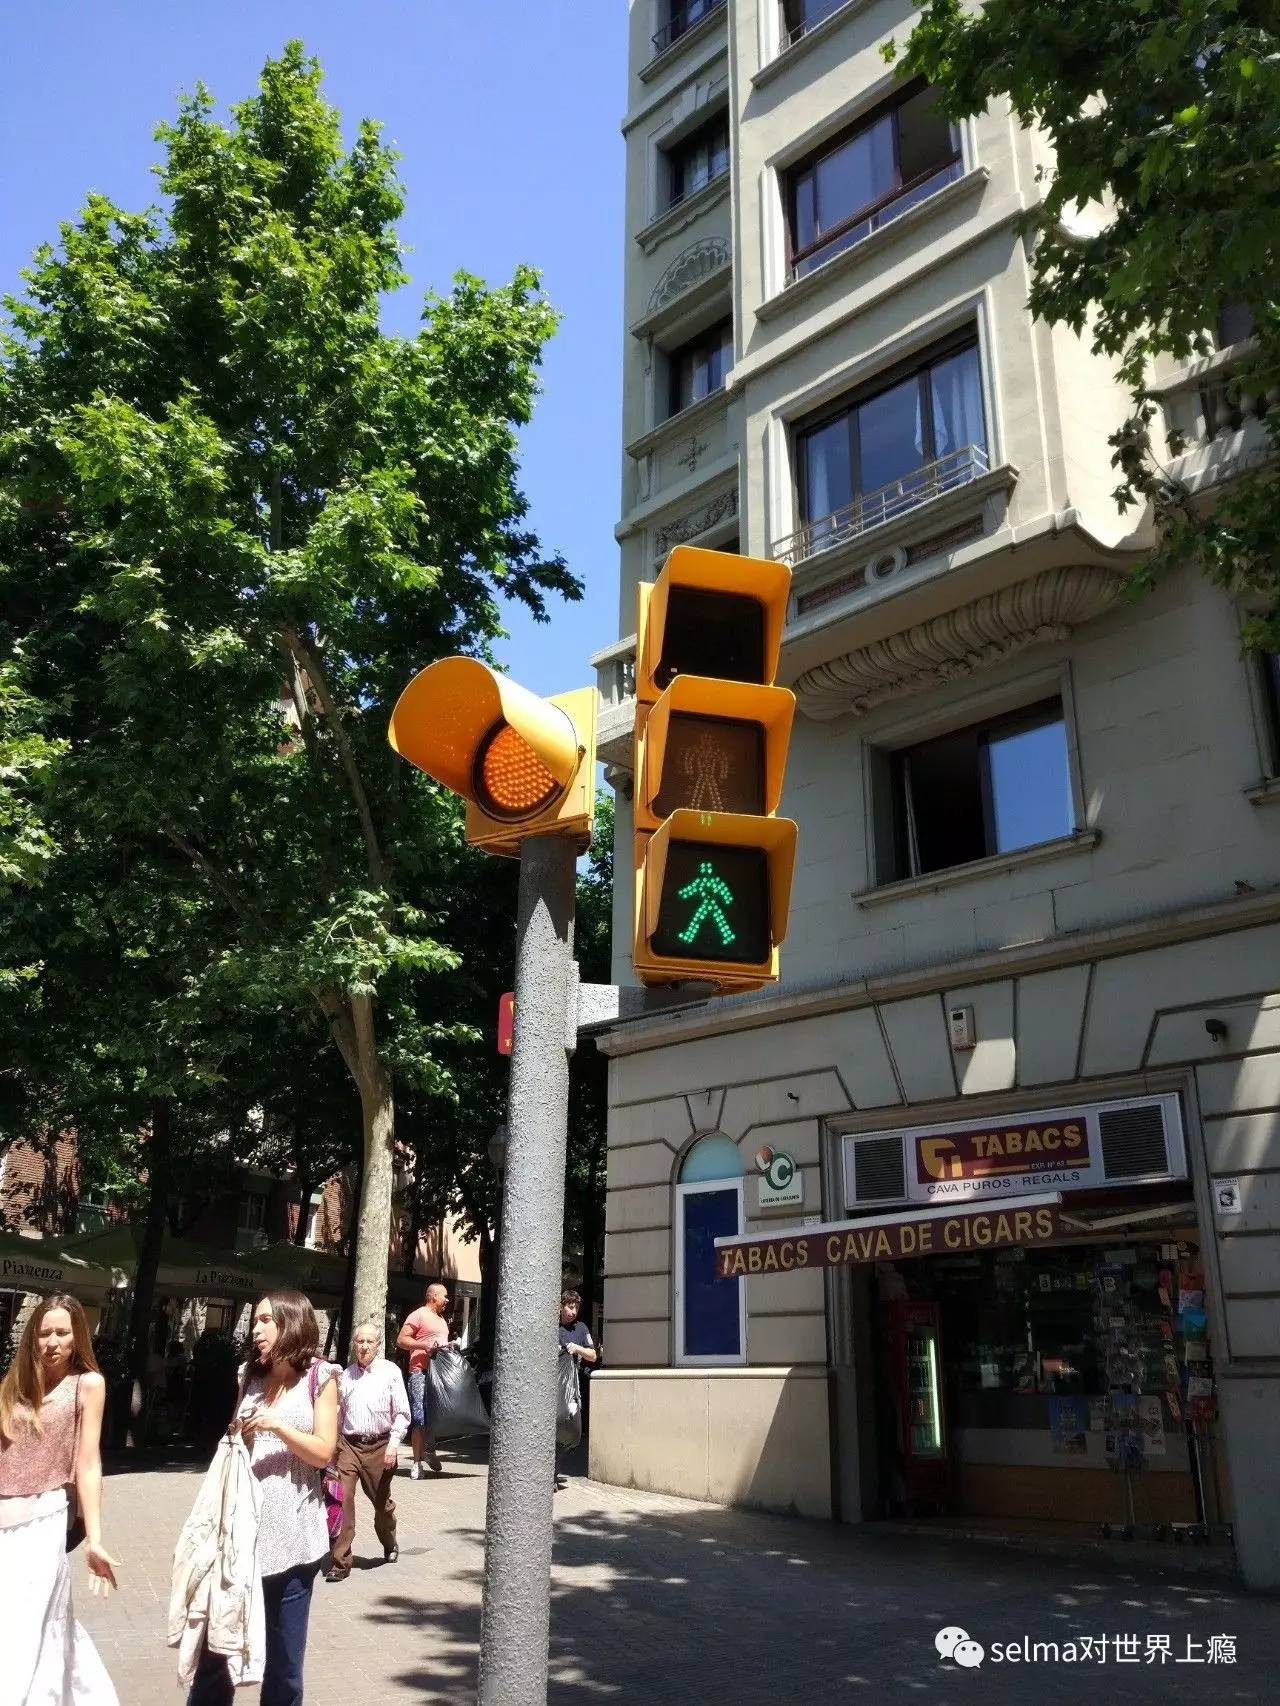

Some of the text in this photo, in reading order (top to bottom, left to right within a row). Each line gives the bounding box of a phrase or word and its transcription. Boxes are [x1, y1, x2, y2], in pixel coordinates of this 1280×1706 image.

[971, 1124, 1082, 1157] TABACS
[927, 1172, 1080, 1194] CAVA PUROS REGALS
[720, 1208, 1053, 1275] TABACS CAVA DE CIGARS
